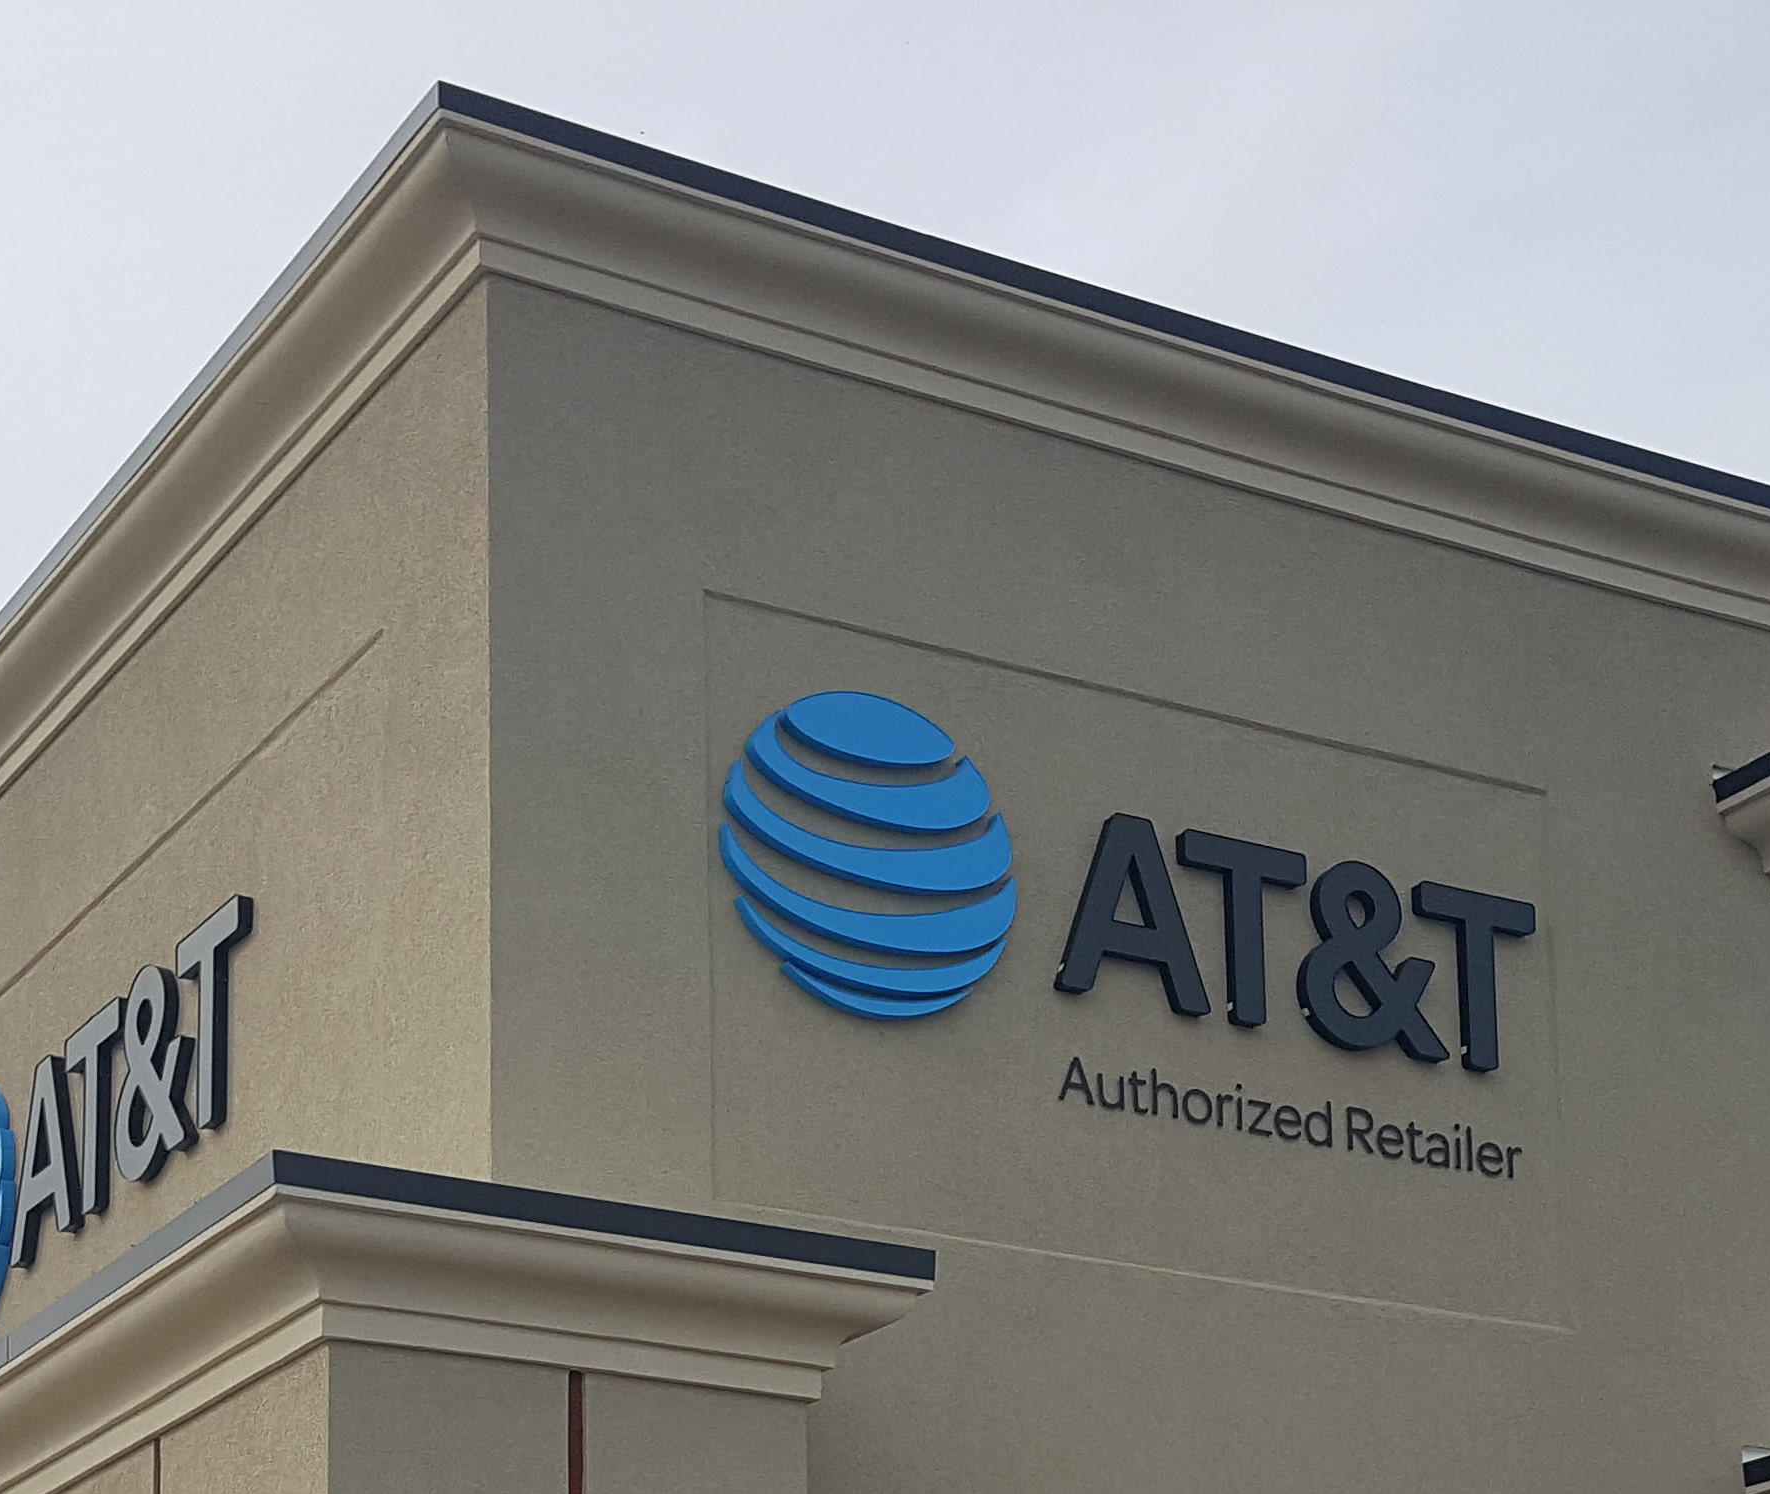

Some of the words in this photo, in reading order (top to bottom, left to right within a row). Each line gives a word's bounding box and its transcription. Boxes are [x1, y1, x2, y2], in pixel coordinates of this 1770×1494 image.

[1053, 812, 1536, 1072] AT&T
[10, 894, 254, 1269] AT&T
[1058, 1056, 1334, 1149] Authorized
[1344, 1105, 1523, 1180] Retailer
